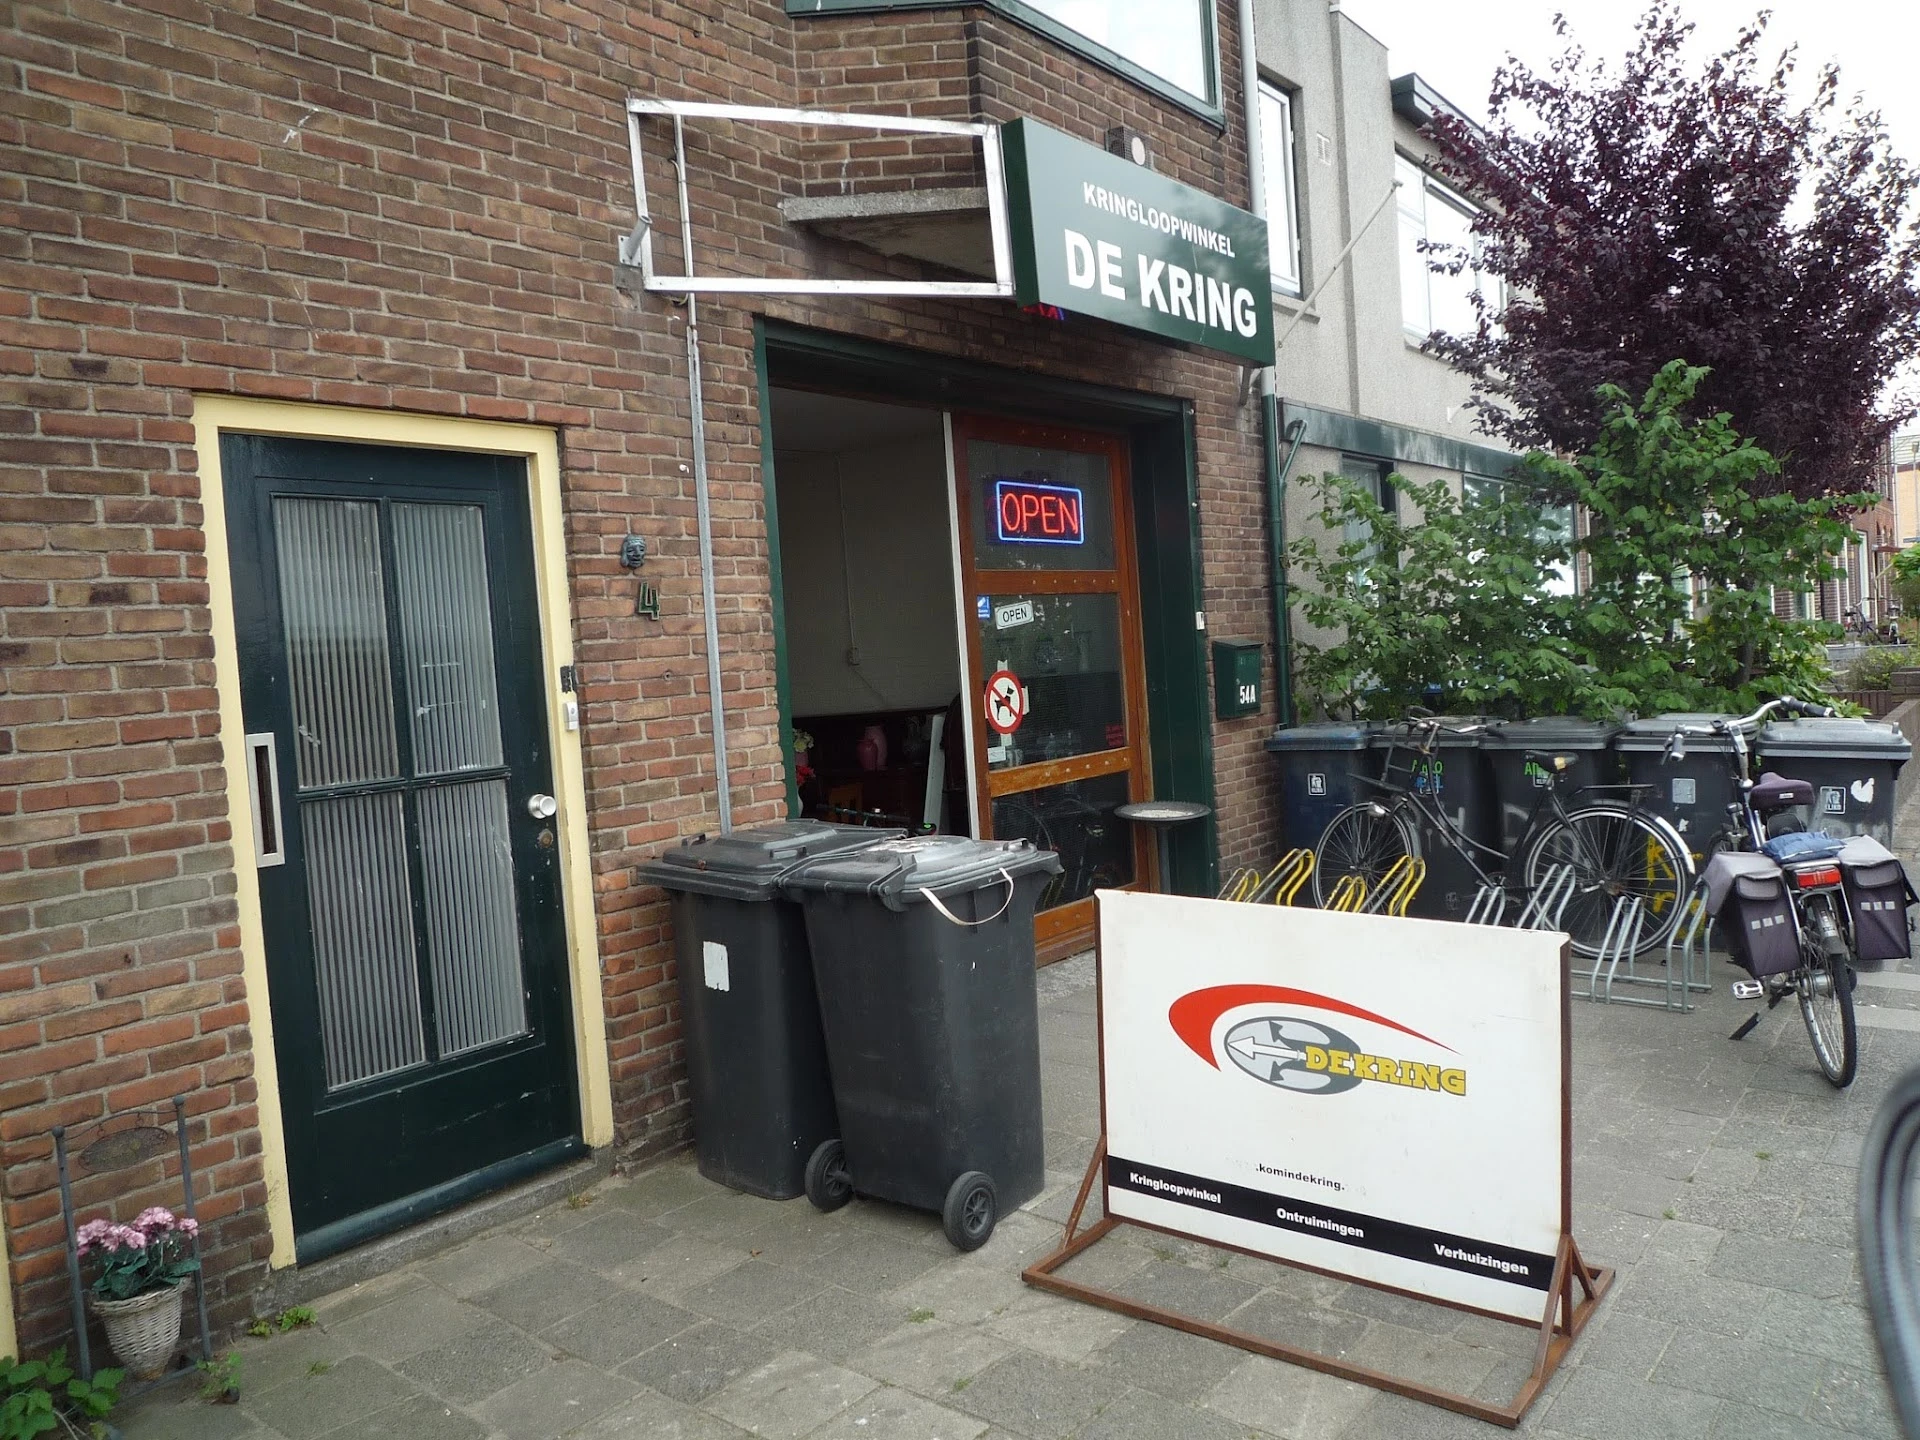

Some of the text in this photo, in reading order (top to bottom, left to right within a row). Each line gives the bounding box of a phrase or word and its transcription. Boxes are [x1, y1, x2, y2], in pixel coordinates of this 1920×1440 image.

[1083, 181, 1236, 258] KRINGLOOPWINKEL
[1064, 228, 1258, 338] DE KRING
[1002, 492, 1079, 535] OPEN
[639, 581, 661, 621] 4
[1002, 606, 1028, 623] OPEN
[1239, 684, 1257, 705] 54A
[1129, 1172, 1529, 1275] Kringloopwinkel Ontruimingen Verhuizingen
